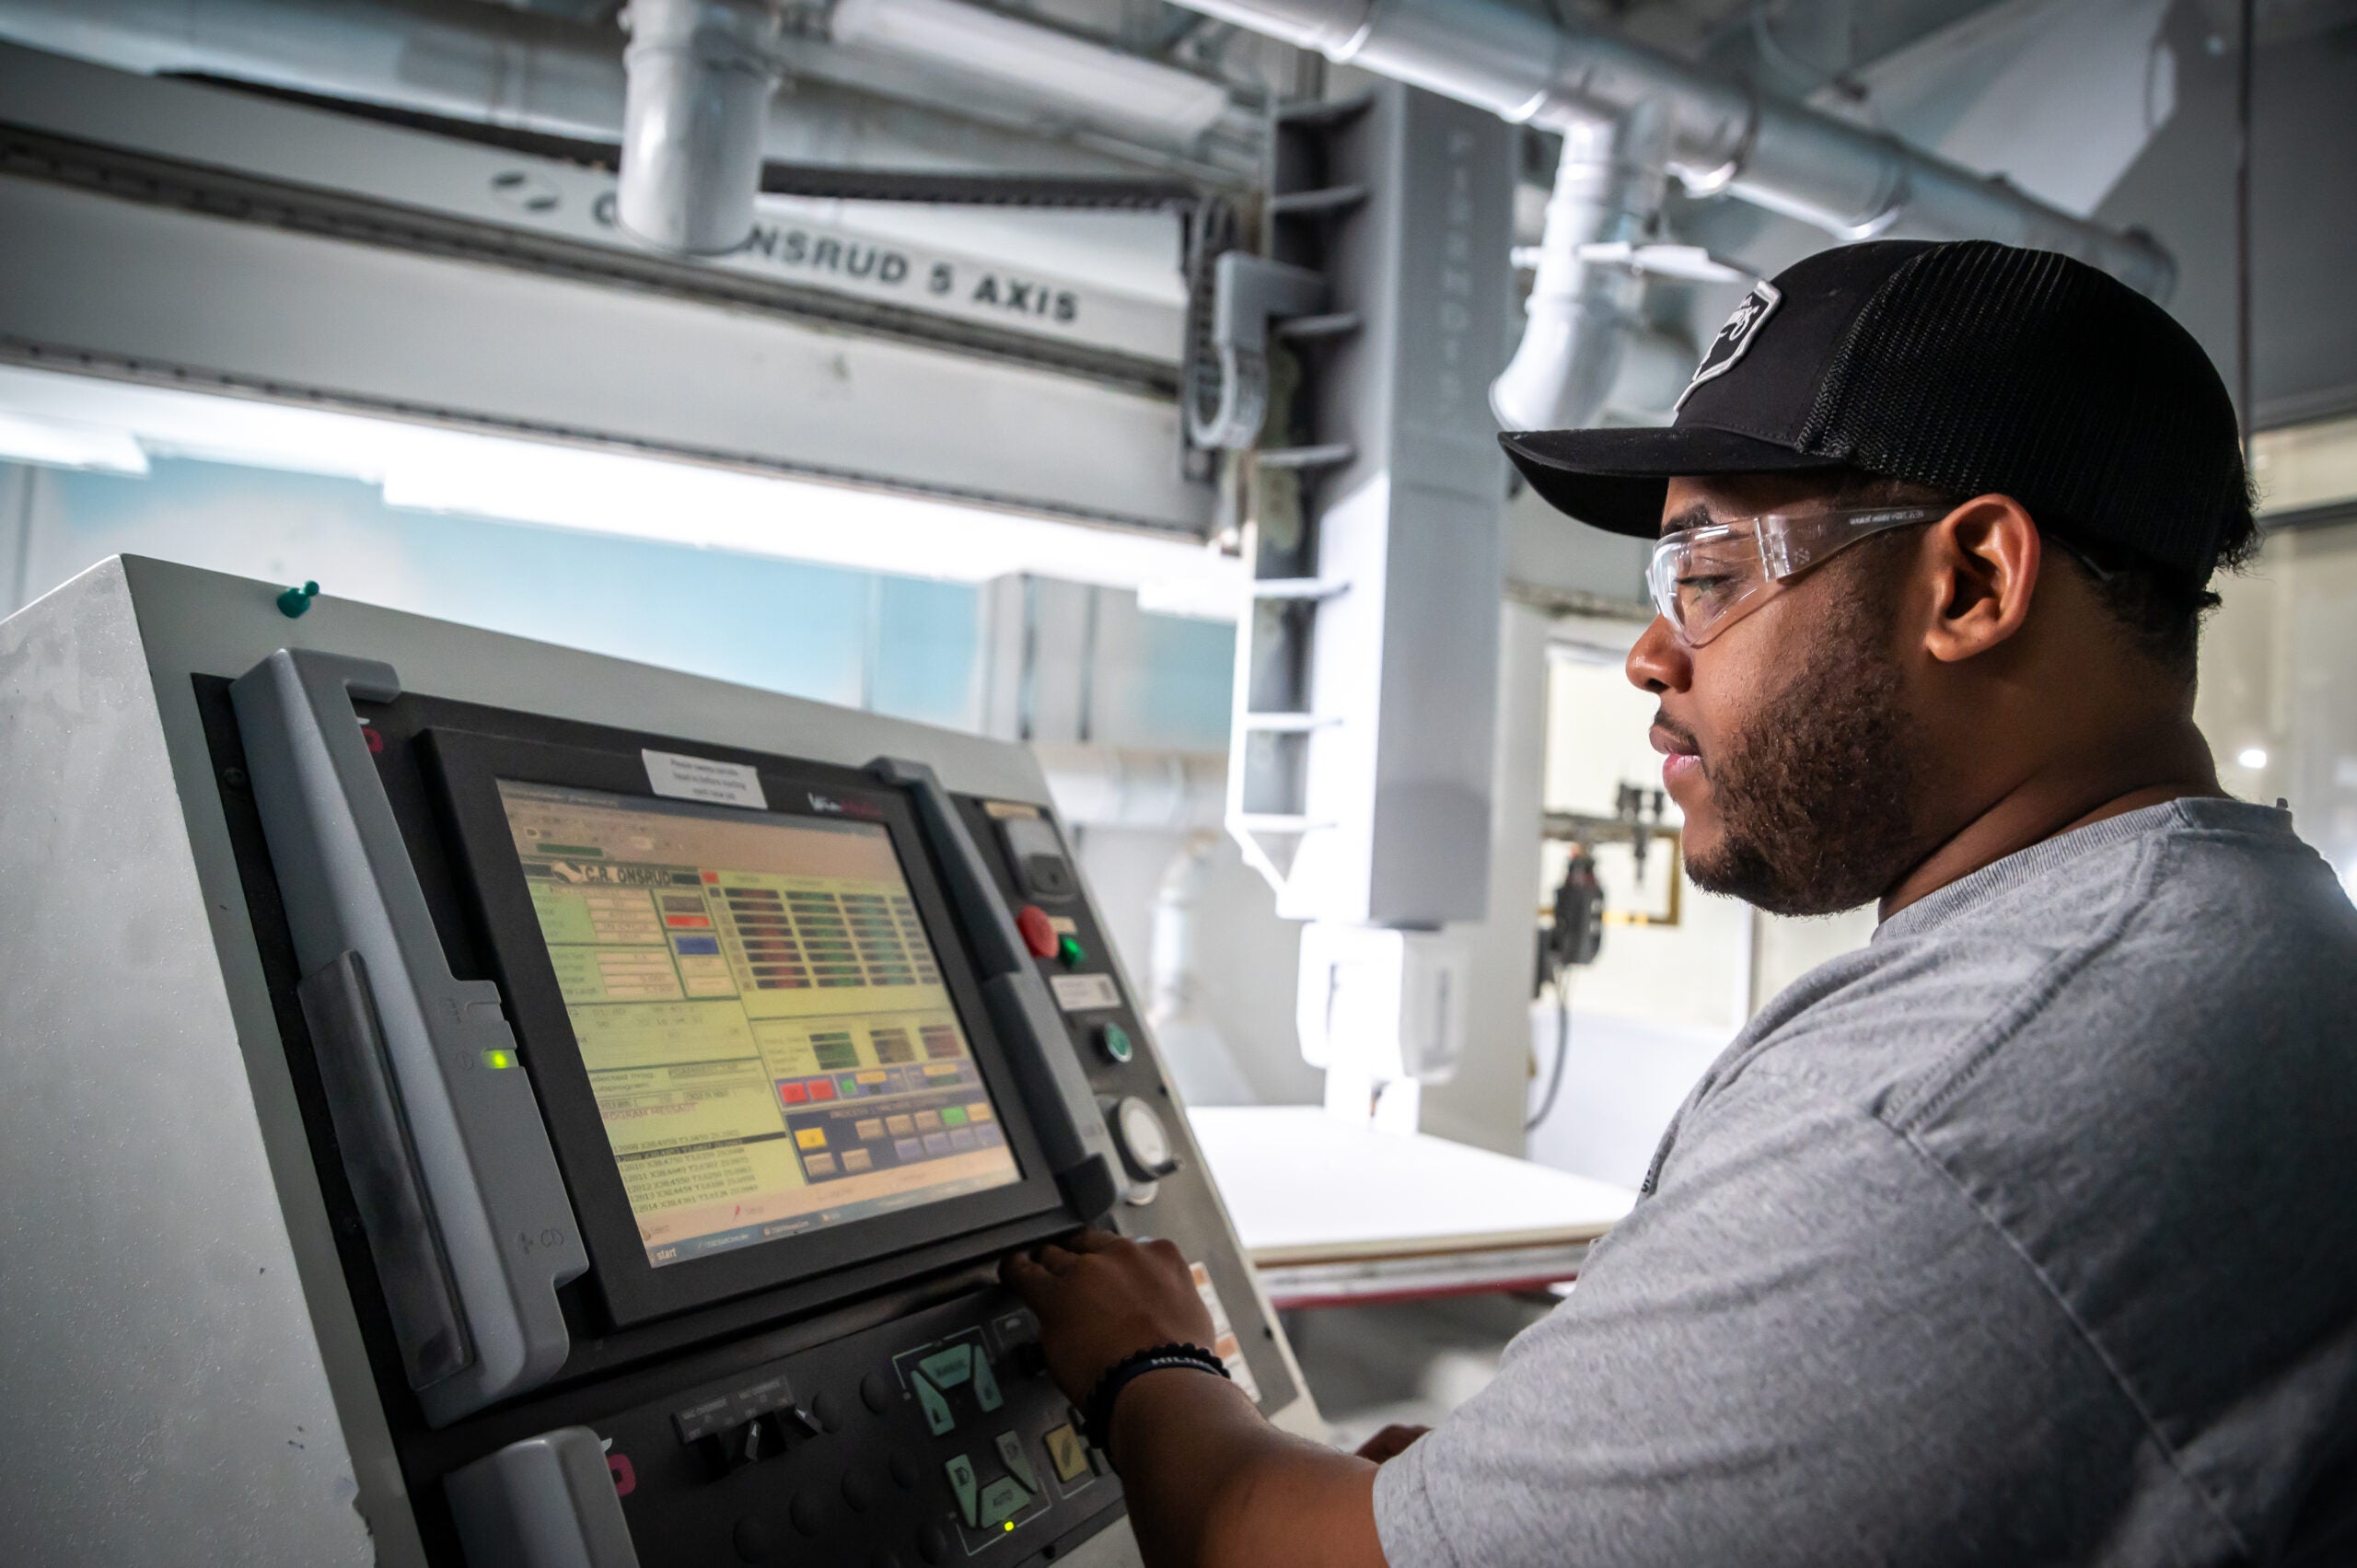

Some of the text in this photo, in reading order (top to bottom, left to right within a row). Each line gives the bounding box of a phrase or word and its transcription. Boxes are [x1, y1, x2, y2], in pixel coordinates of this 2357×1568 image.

[746, 222, 908, 285] NSRUD
[928, 263, 952, 295] 5
[972, 275, 1078, 323] AXIS
[617, 868, 672, 886] ONSRUD
[656, 1249, 678, 1260] start
